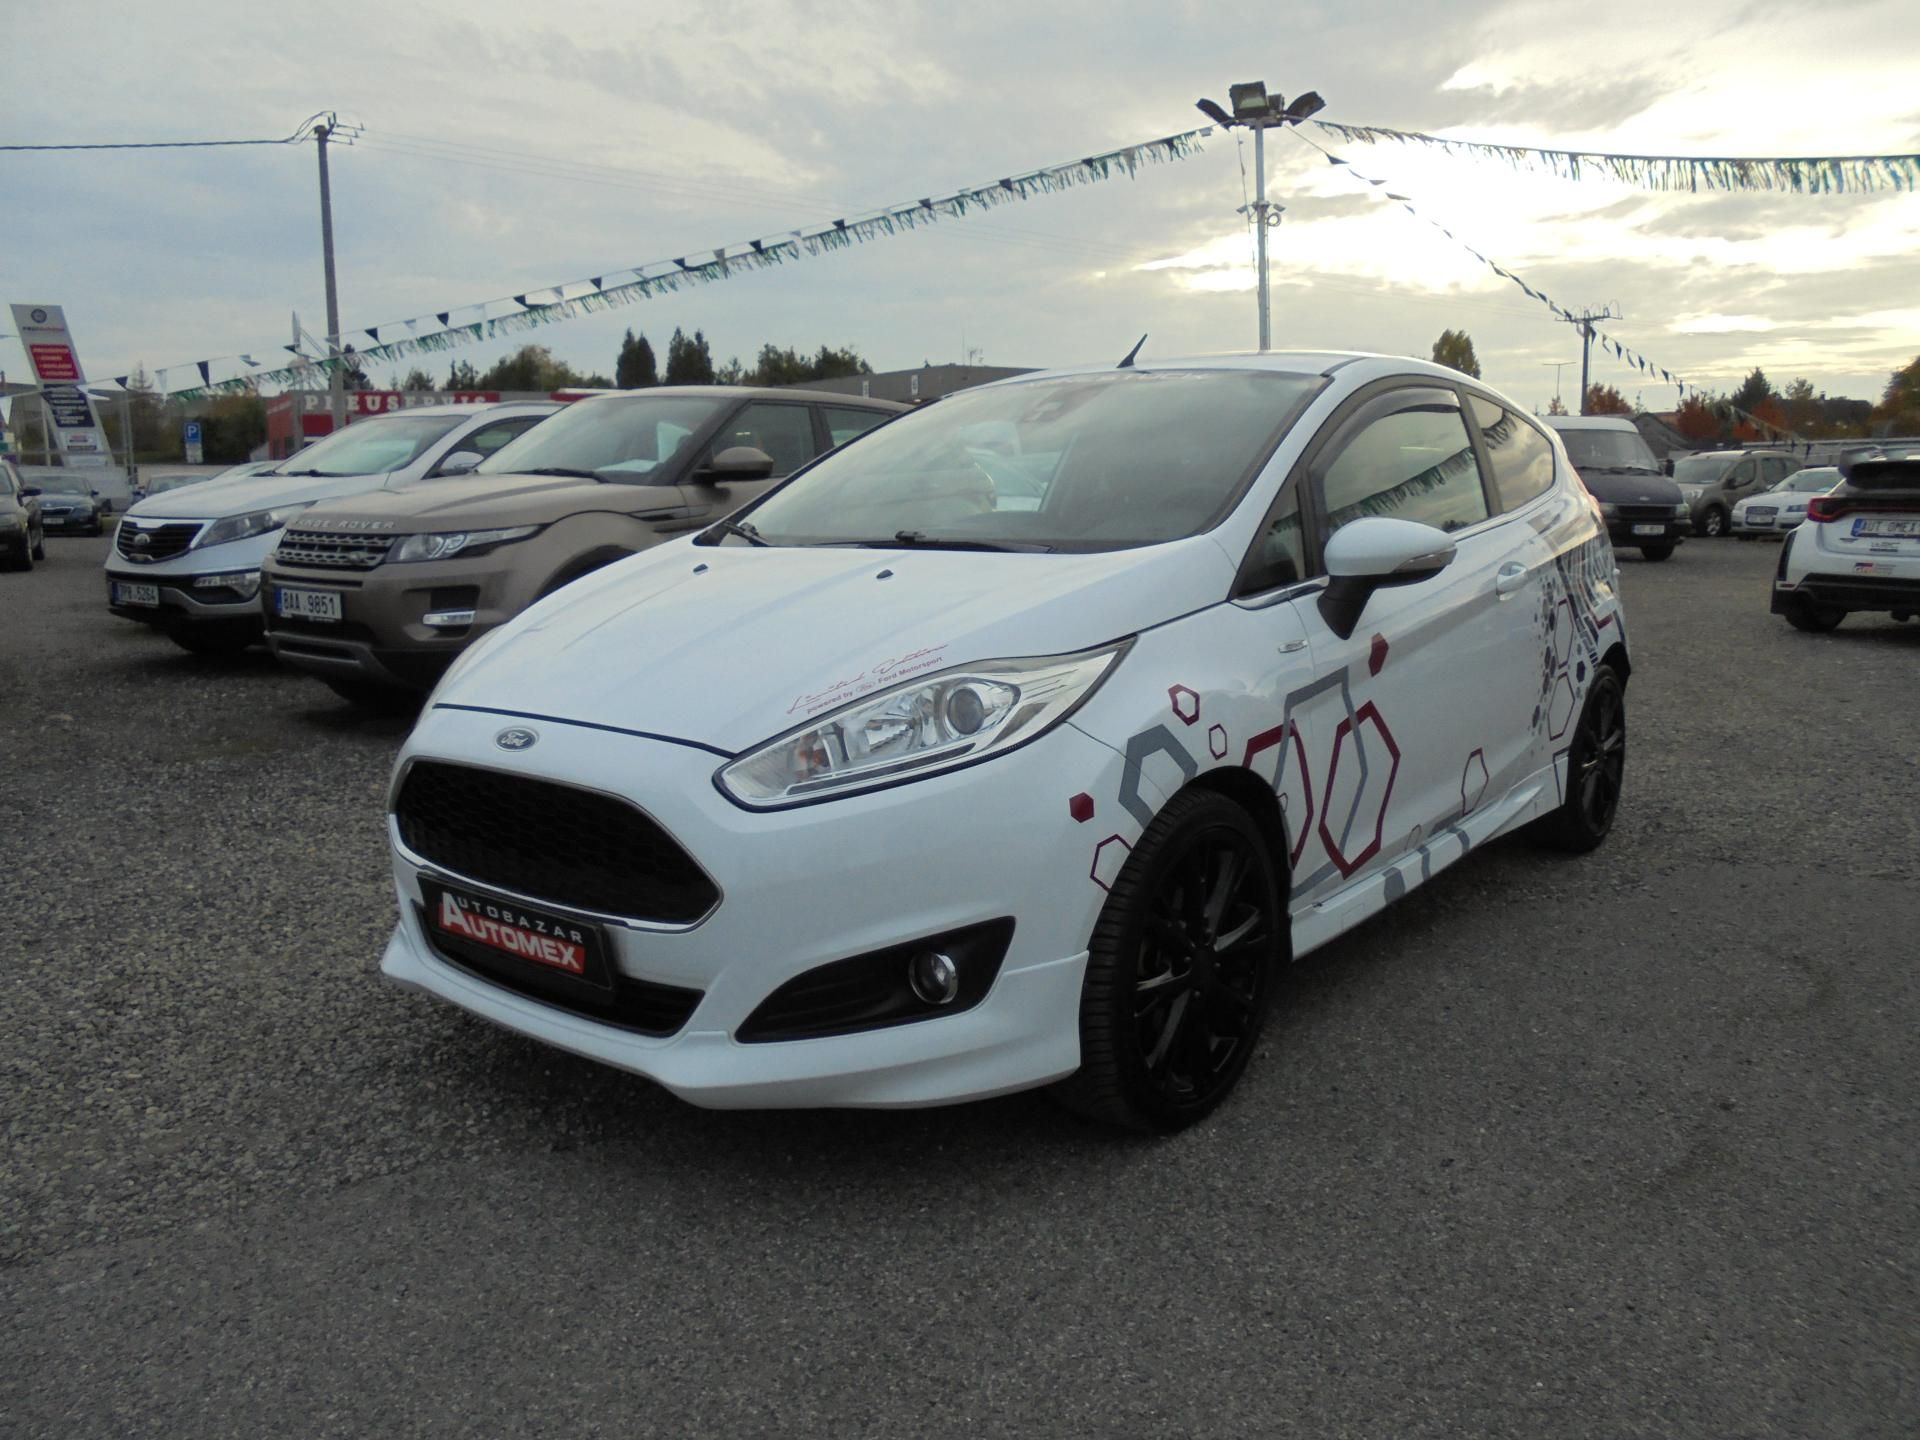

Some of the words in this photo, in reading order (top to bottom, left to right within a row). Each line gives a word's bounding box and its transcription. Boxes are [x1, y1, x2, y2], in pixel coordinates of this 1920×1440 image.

[187, 425, 198, 438] P
[338, 520, 394, 528] ROVER
[283, 591, 300, 611] 8AA
[308, 594, 336, 616] 9851
[843, 691, 853, 700] by
[878, 673, 897, 684] Ford
[898, 656, 943, 676] Motorsport
[500, 731, 529, 747] Ford
[442, 892, 580, 969] AUTOMEX
